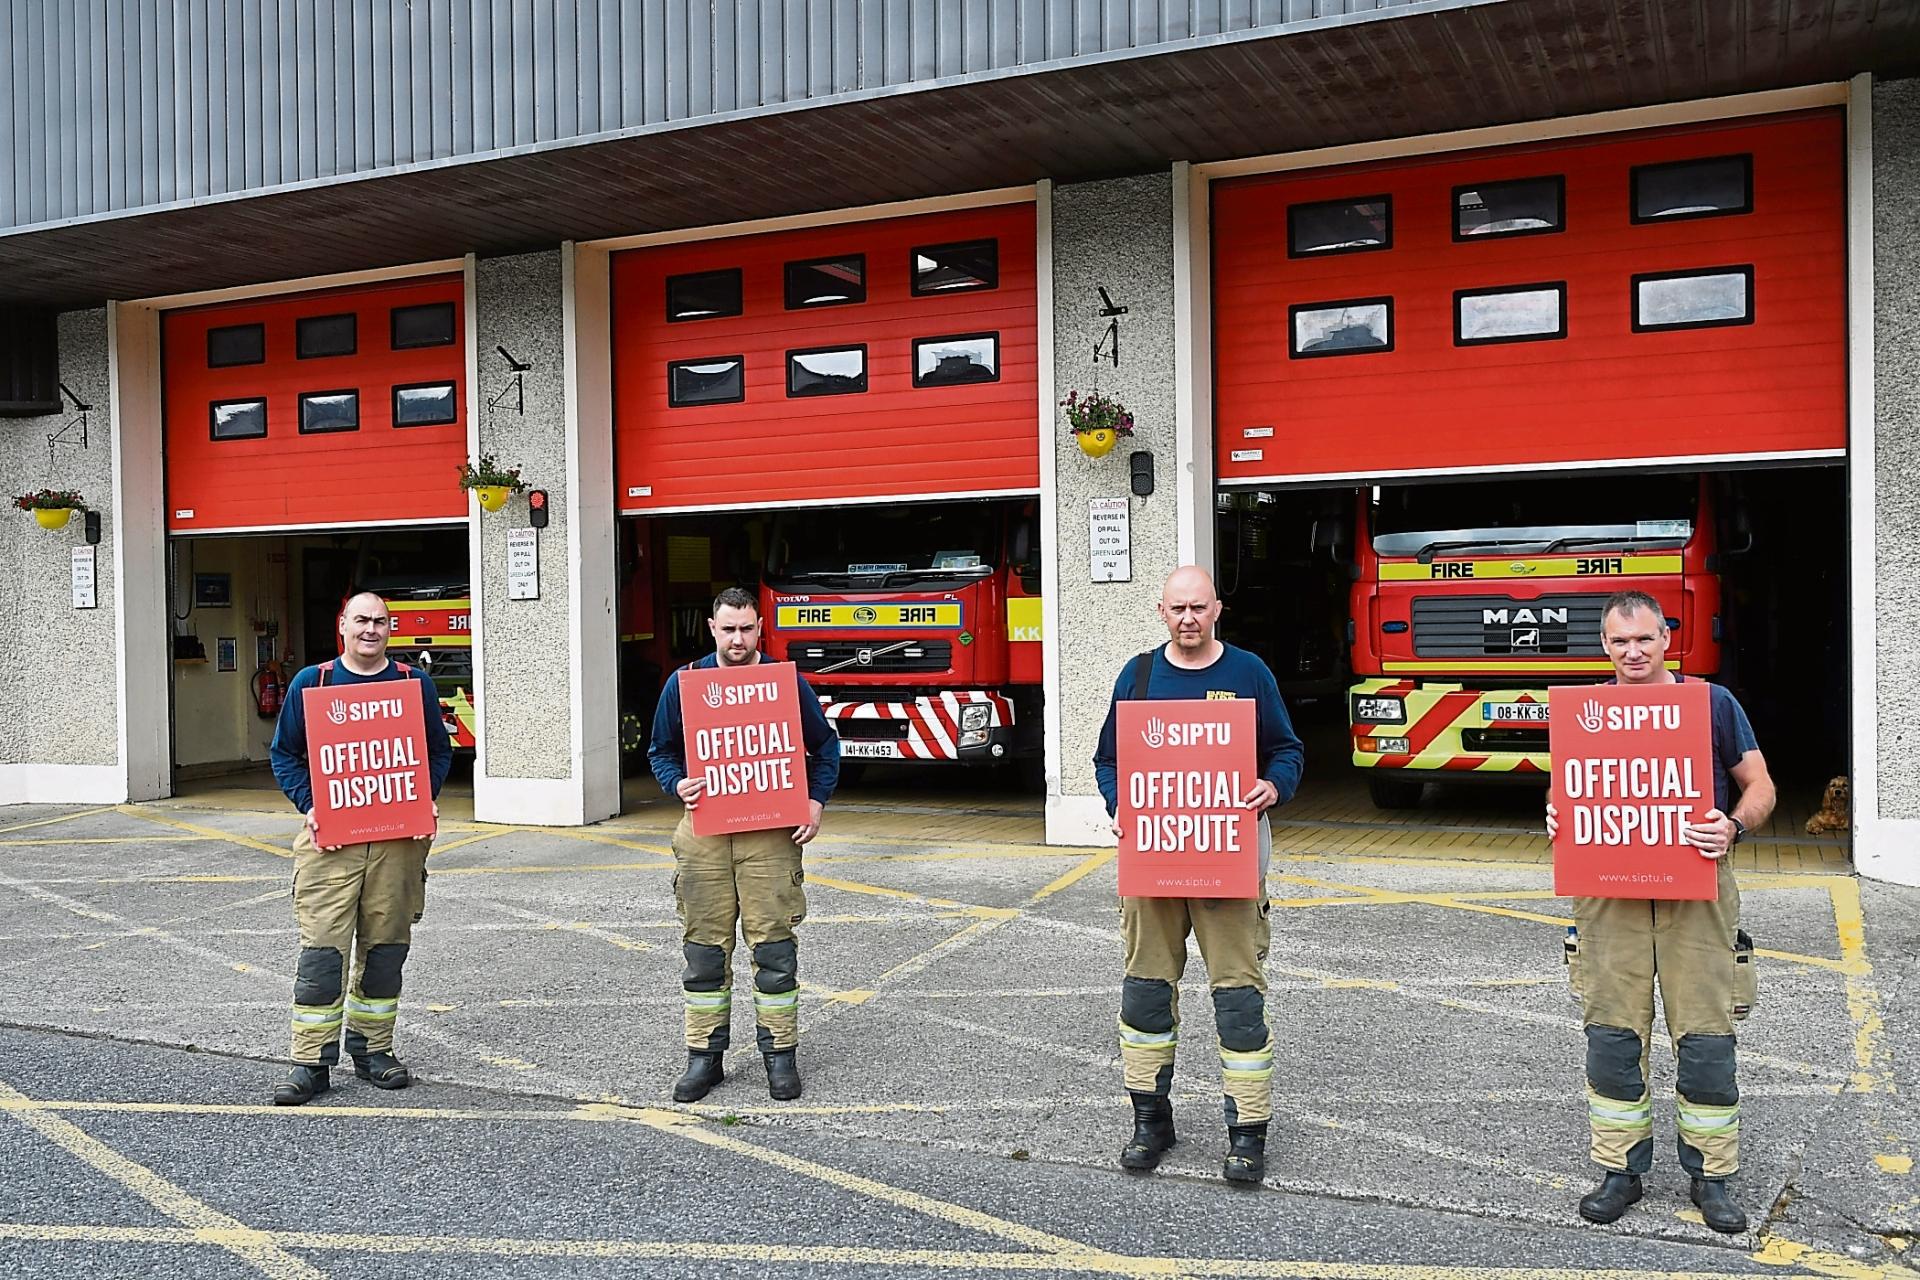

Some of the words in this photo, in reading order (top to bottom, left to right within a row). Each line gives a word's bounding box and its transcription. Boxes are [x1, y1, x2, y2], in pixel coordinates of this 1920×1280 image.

[1431, 563, 1474, 578] FIRE
[776, 595, 810, 603] VOLVO
[798, 609, 831, 623] FIRE
[1483, 608, 1568, 625] MAN
[725, 682, 778, 705] SIPTU
[350, 699, 403, 721] SIPTU
[1607, 705, 1680, 731] SIPTU
[696, 721, 796, 761] OFFICIAL
[1167, 722, 1230, 746] SIPTU
[319, 736, 421, 776] OFFICIAL
[845, 745, 891, 756] 141-KK-1453
[704, 757, 794, 797] DISPUTE
[1564, 757, 1701, 799] OFFICIAL
[328, 771, 418, 810] DISPUTE
[1130, 771, 1247, 809] OFFICIAL
[351, 823, 405, 835] www.siptu.ie
[726, 811, 781, 824] www.siptu.ie
[1573, 804, 1694, 846] DISPUTE
[1137, 814, 1241, 852] DISPUTE
[1156, 877, 1222, 887] www.siptu.ie
[1599, 872, 1673, 883] www.siptu.ie
